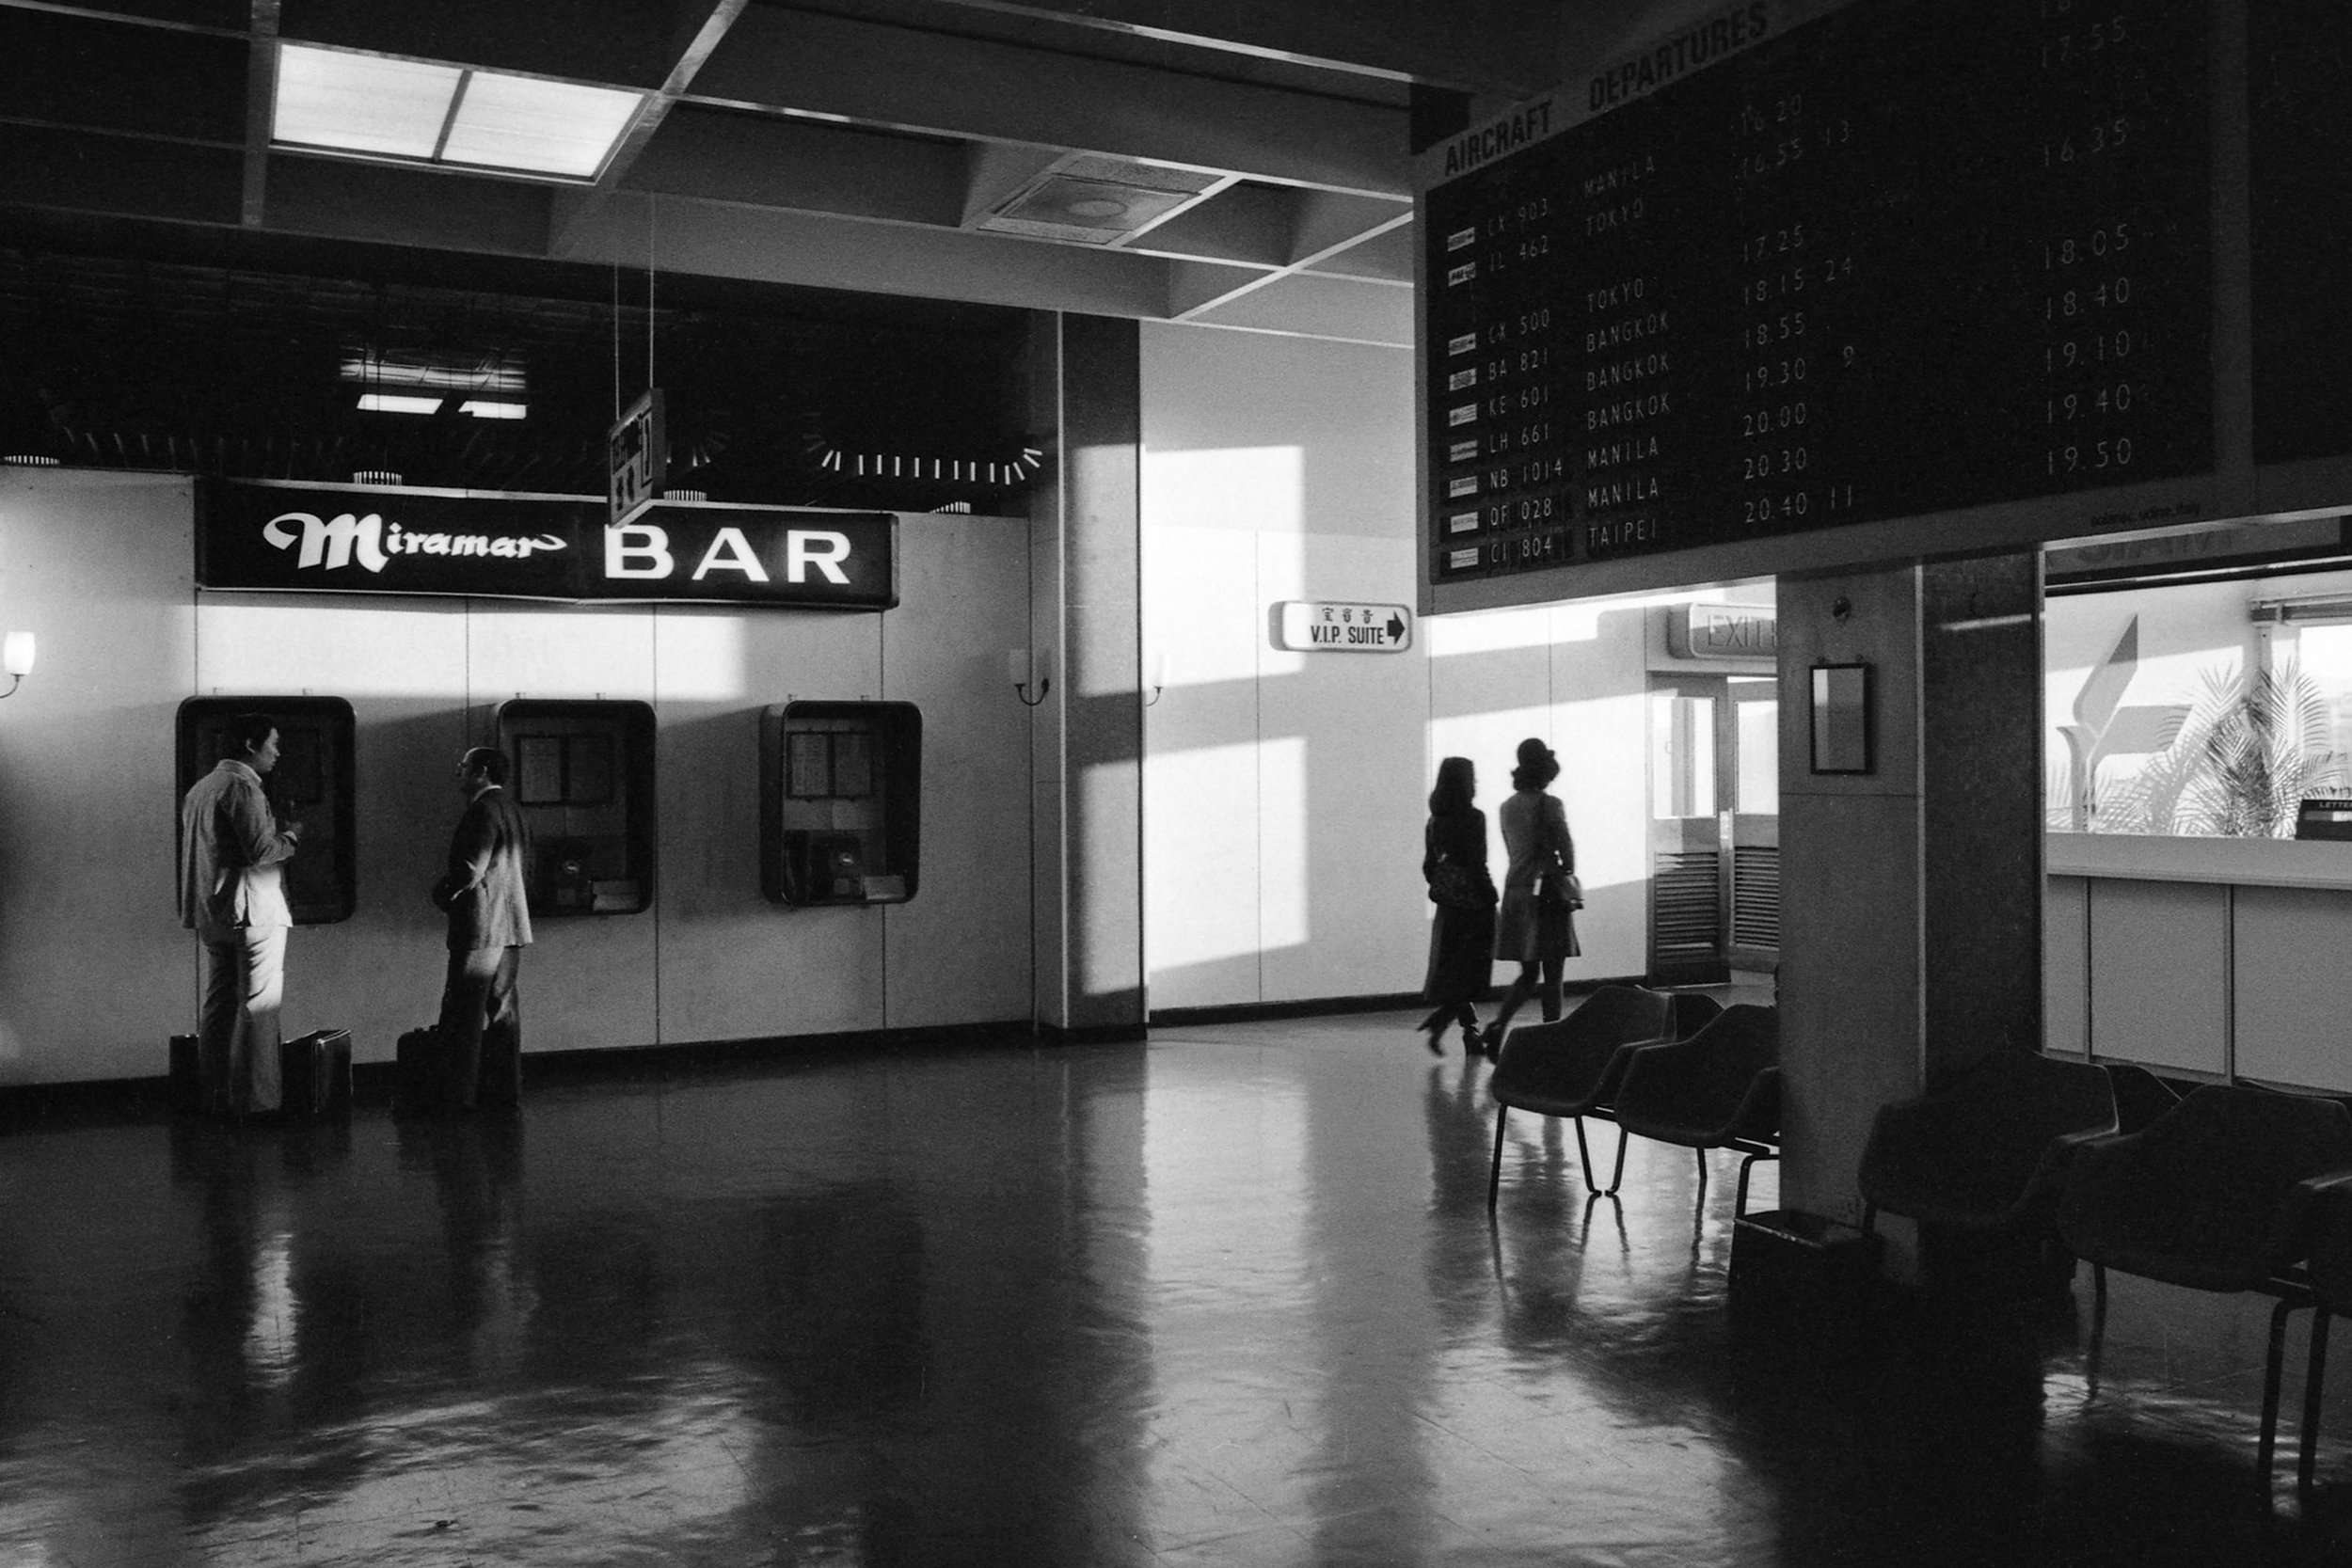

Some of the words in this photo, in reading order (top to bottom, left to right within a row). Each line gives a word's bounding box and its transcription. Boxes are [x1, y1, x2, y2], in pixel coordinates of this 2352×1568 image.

[1445, 100, 1552, 177] AIRCRAFT
[1589, 1, 1769, 111] DEPARTURES
[1583, 155, 1657, 198] MANILA
[1518, 234, 1549, 260] 462
[1585, 198, 1645, 237] TOKYO
[1487, 322, 1507, 344] CX
[1519, 309, 1550, 333] 500
[1586, 277, 1645, 313] TOKYO
[1487, 358, 1508, 381] BA
[1519, 347, 1549, 372] 821
[1586, 311, 1670, 352] BANGKOK
[1824, 256, 1852, 283] 24
[1488, 394, 1507, 417] KE
[1519, 383, 1549, 407] 601
[1586, 351, 1671, 392] BANGKOK
[1489, 431, 1510, 454] LH
[1520, 421, 1549, 446] 661
[1587, 391, 1672, 431] BANGKOK
[1841, 344, 1855, 370] 9
[1489, 467, 1509, 489] NB
[1521, 458, 1564, 483] 1014
[1587, 436, 1659, 470] MANILA
[1490, 542, 1506, 562] CI
[1521, 536, 1552, 558] 804
[1588, 516, 1657, 547] TAIPEI
[1829, 483, 1852, 510] 11
[1521, 497, 1551, 520] 028
[1587, 477, 1660, 509] MANILA
[262, 512, 568, 573] Miramar
[604, 524, 851, 584] BAR
[1311, 625, 1342, 643] V.I.P.
[1347, 626, 1385, 645] SUITE
